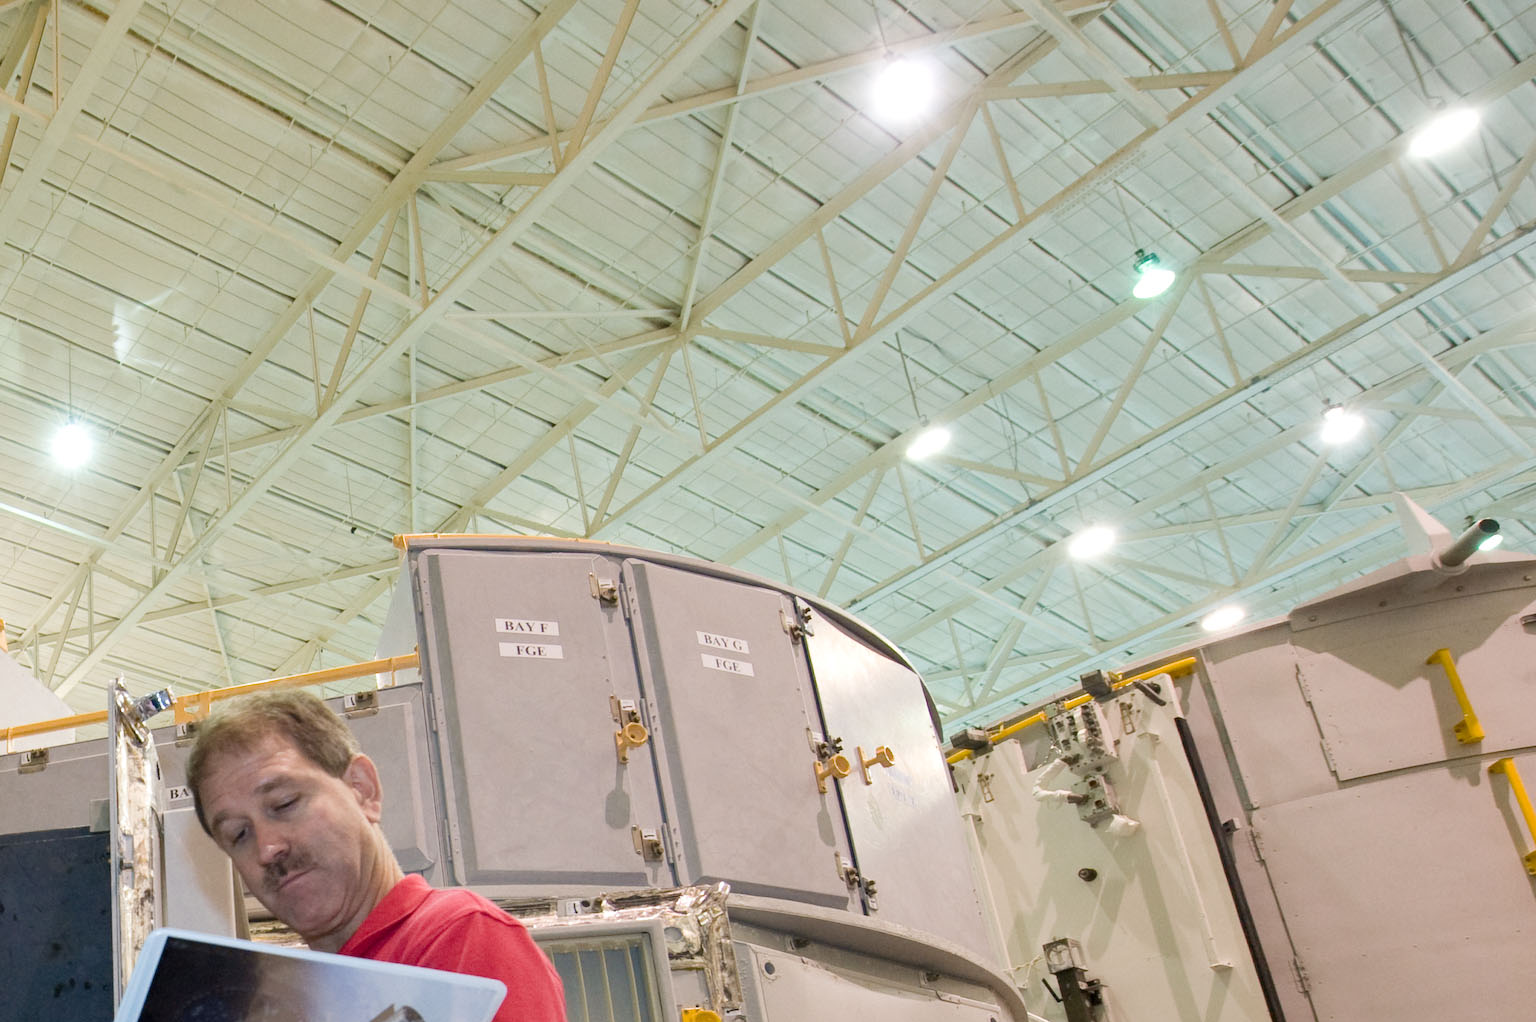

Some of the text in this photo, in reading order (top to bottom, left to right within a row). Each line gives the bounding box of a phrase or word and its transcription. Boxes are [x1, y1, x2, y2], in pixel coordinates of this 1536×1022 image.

[505, 620, 548, 633] BAY F
[704, 634, 729, 648] BAY
[516, 645, 547, 656] FGE
[170, 788, 190, 799] BA
